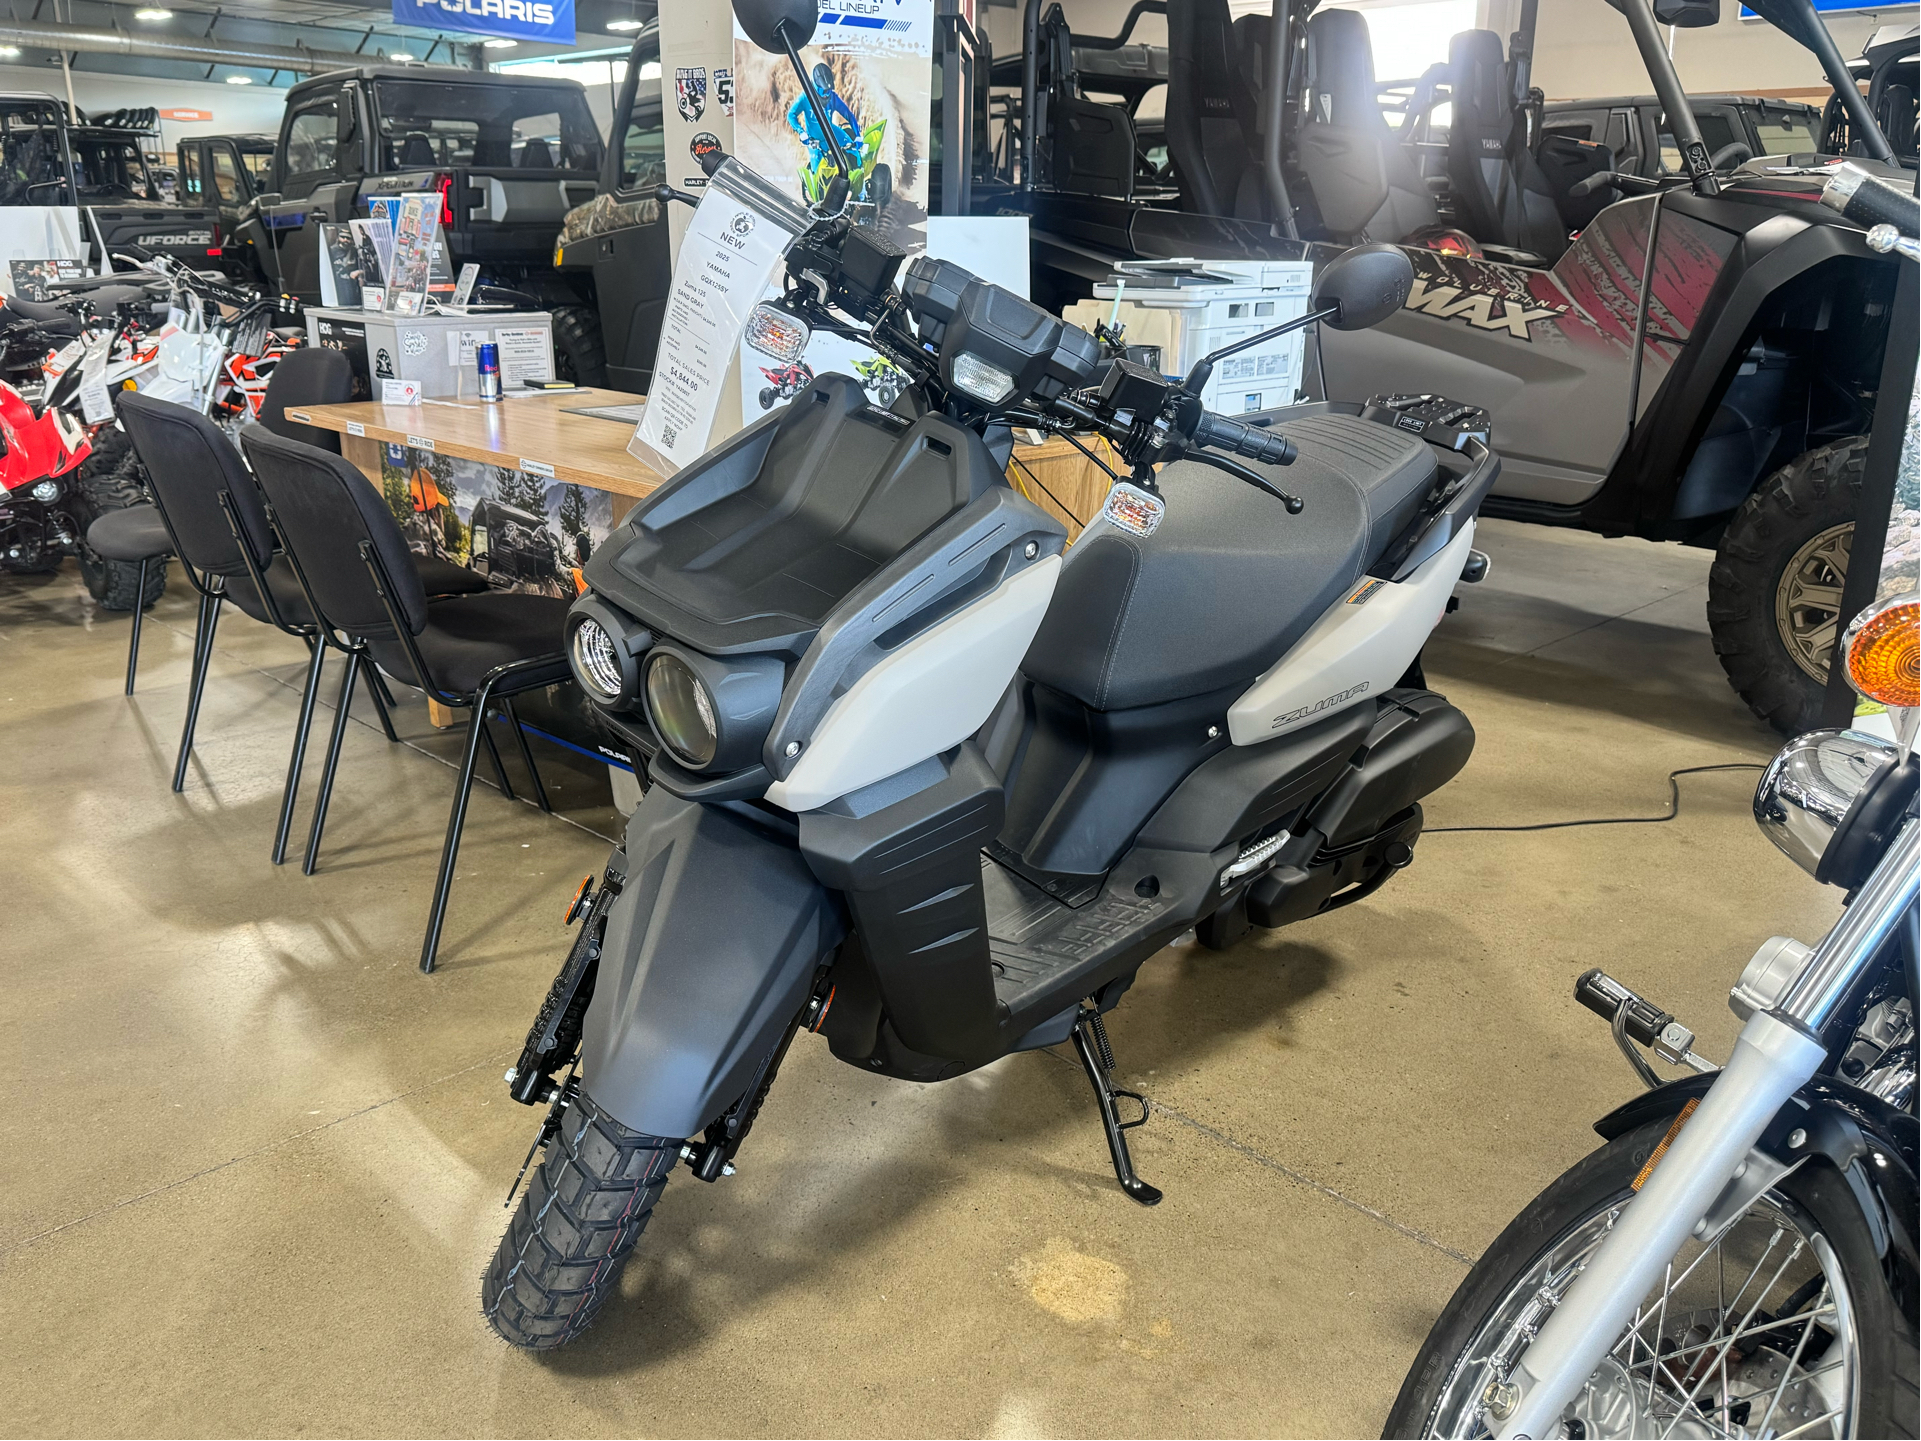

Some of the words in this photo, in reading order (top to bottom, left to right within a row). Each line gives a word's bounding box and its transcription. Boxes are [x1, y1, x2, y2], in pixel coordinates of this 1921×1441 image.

[839, 2, 880, 15] LINEUP
[137, 234, 211, 246] UFORCE
[719, 231, 746, 250] NEW
[715, 250, 731, 262] 2025
[706, 260, 731, 279] YAMAHA
[684, 280, 698, 293] Zuma
[697, 288, 707, 298] 125
[484, 364, 499, 372] Red
[667, 352, 682, 367] TOTAL
[681, 362, 697, 377] SALES
[696, 372, 711, 387] PRICE
[669, 366, 699, 392] $4,844.00
[1271, 681, 1370, 729] ZUMA
